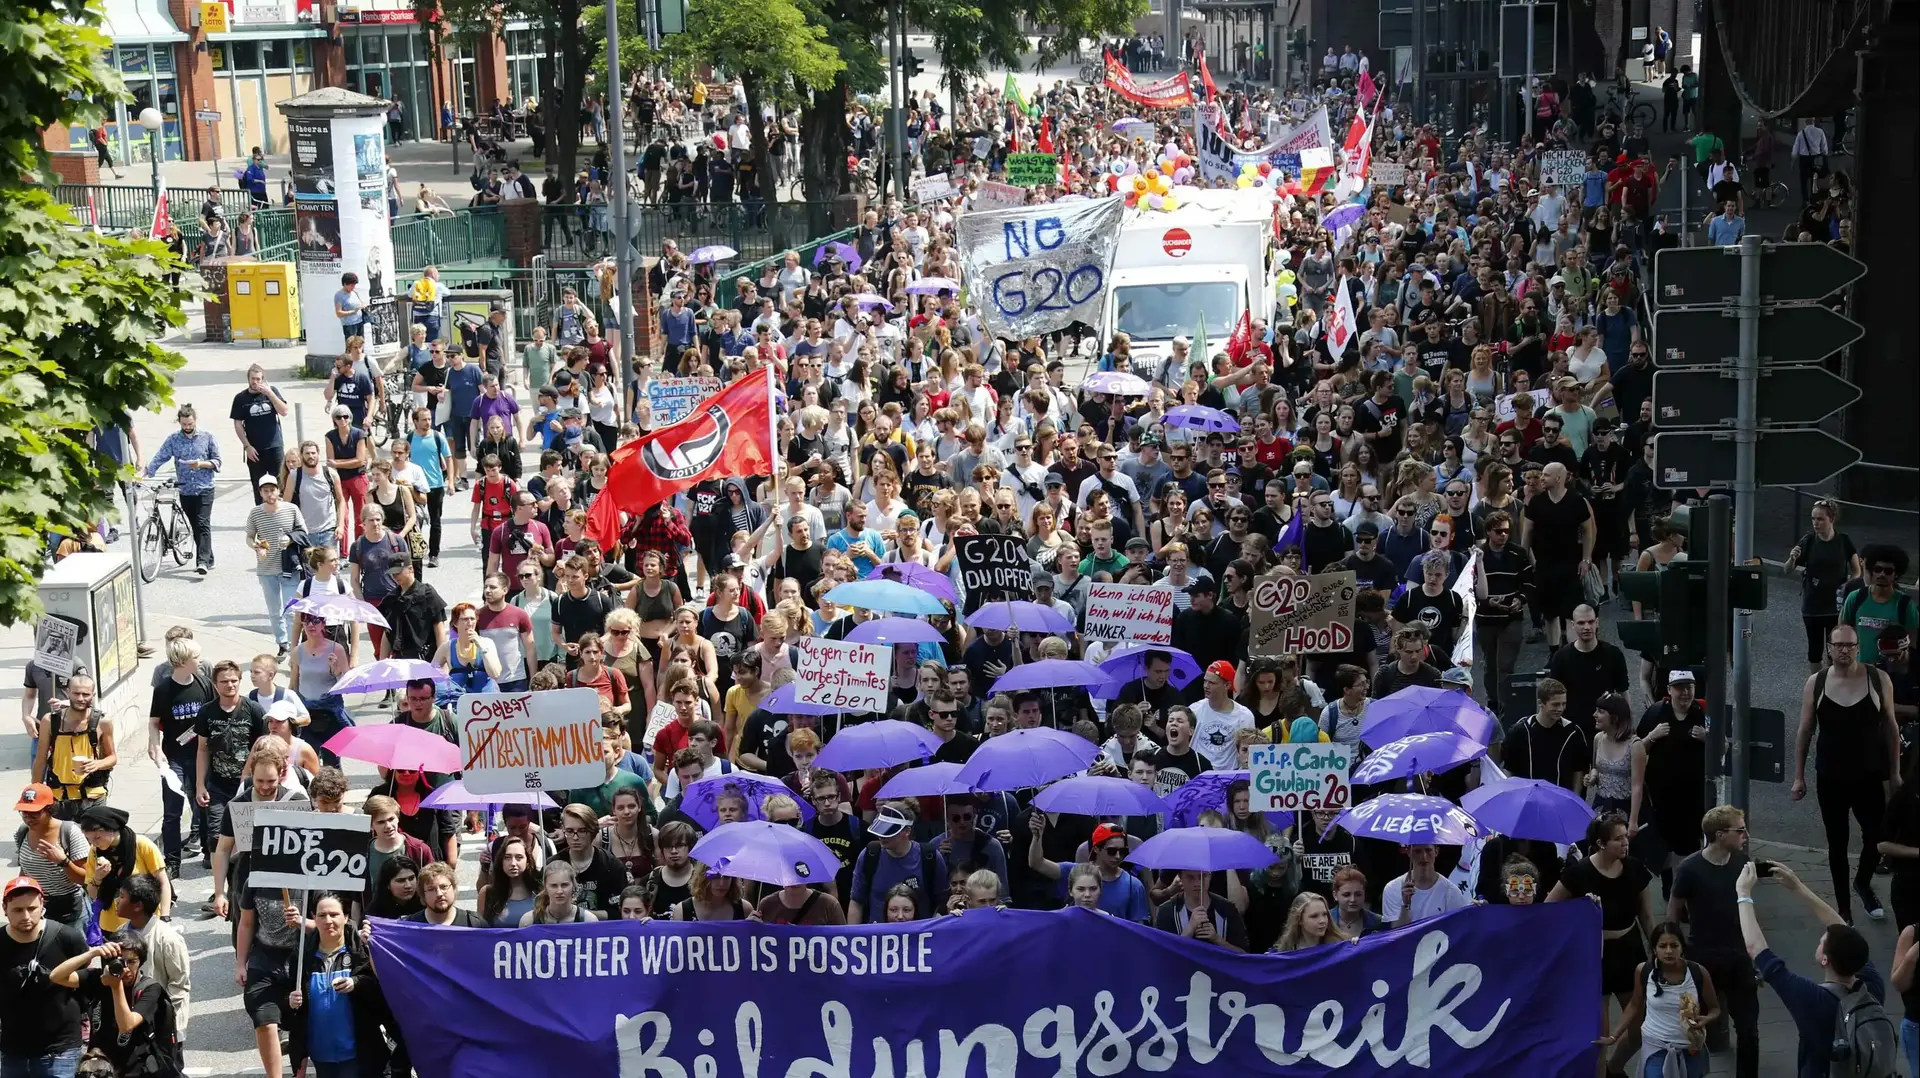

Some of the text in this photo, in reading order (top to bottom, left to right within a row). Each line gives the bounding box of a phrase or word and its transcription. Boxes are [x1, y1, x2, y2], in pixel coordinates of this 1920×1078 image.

[361, 11, 390, 22] Hamburger
[295, 125, 329, 133] Sheeran
[1556, 167, 1573, 175] G20
[321, 203, 334, 212] TEN
[993, 264, 1103, 316] G20
[648, 381, 721, 397] Grenzen und
[696, 493, 717, 504] FCK
[965, 569, 992, 590] DU
[1088, 584, 1123, 600] Wenn
[1127, 589, 1145, 602] ich
[1254, 576, 1311, 618] G20
[1088, 604, 1110, 621] bin,
[1112, 607, 1137, 620] will
[1137, 609, 1155, 622] ich
[42, 619, 75, 637] WANTED
[1084, 622, 1171, 643] BANKER werden
[798, 668, 886, 691] vorbestimmtes
[802, 683, 881, 711] Leben
[1253, 744, 1292, 770] r.i.p.
[1293, 747, 1348, 771] Carlo
[525, 780, 542, 789] G20
[1270, 792, 1299, 809] no
[1302, 774, 1349, 810] G20
[231, 805, 254, 817] WIR
[1371, 814, 1452, 834] LIEBER
[261, 827, 324, 856] HDF
[300, 847, 368, 877] G20
[1302, 854, 1350, 868] WE ARE ALL
[1312, 868, 1329, 880] THE
[493, 932, 933, 980] ANOTHER WORLD IS POSSIBLE
